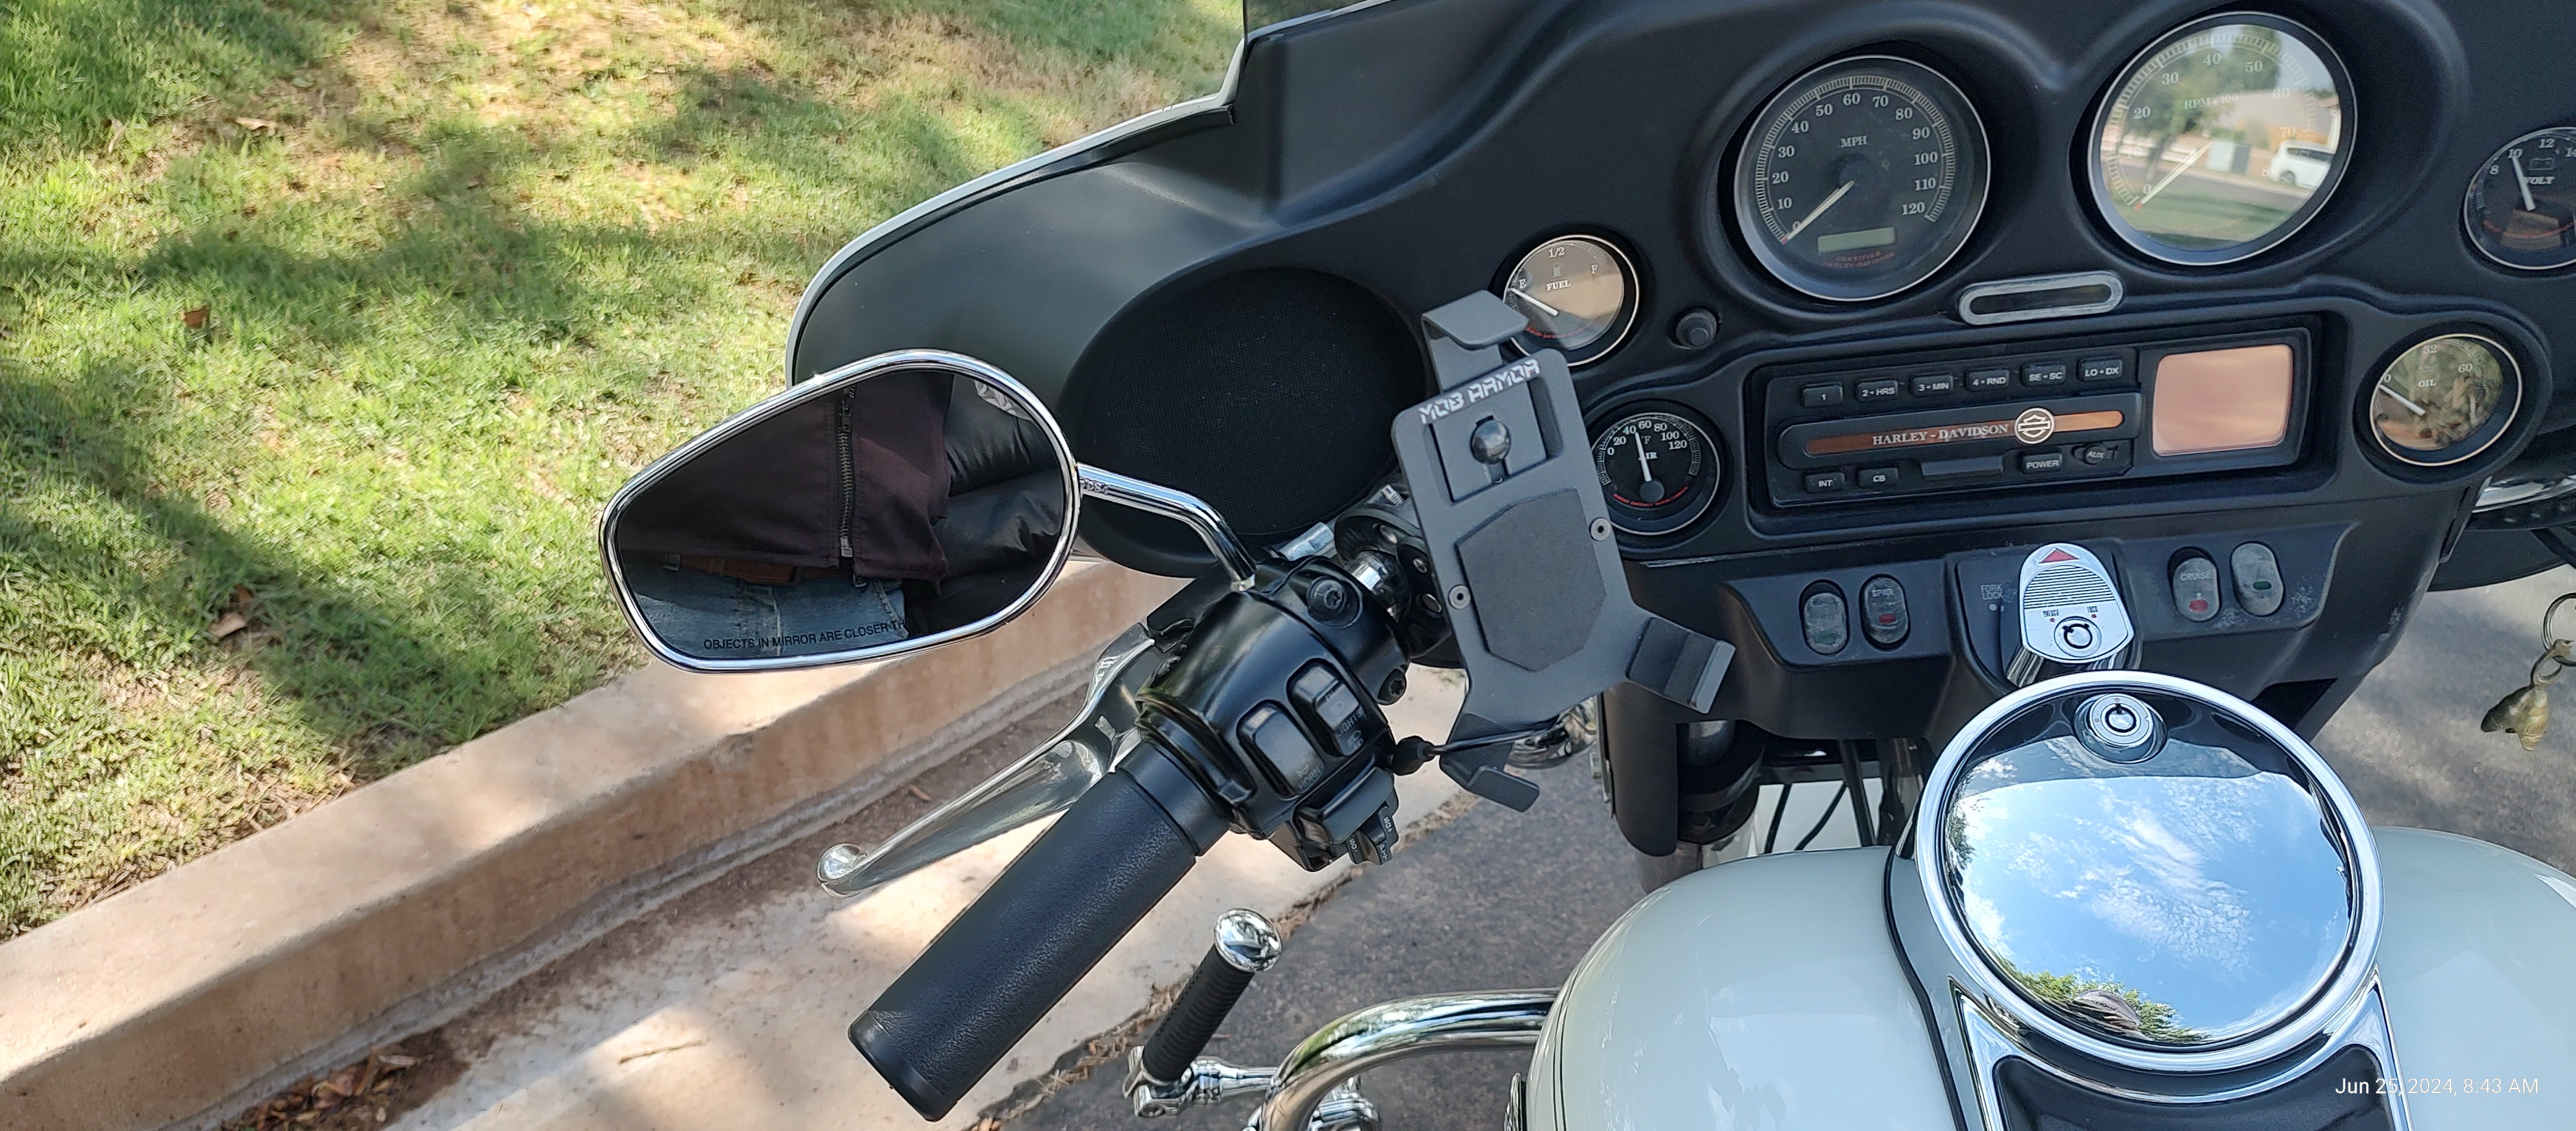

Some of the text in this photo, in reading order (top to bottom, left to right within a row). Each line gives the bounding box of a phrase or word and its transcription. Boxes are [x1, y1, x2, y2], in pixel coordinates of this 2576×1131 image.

[2203, 53, 2221, 65] 40
[2245, 60, 2263, 73] 50
[2161, 72, 2179, 85] 30
[2272, 87, 2290, 99] 60
[1842, 93, 1861, 106] 60
[1872, 95, 1889, 108] 70
[2184, 97, 2211, 109] RPM
[2221, 94, 2239, 104] 100
[1815, 104, 1833, 117] 50
[1895, 108, 1913, 120] 80
[2134, 106, 2151, 119] 20
[1791, 120, 1809, 134] 40
[1912, 127, 1930, 140] 90
[1841, 136, 1868, 148] MPH
[2538, 138, 2555, 148] 12
[1778, 145, 1795, 158] 30
[2507, 149, 2523, 158] 10
[1914, 151, 1938, 166] 100
[2262, 165, 2278, 177] 80
[2490, 166, 2499, 175] 8
[1772, 171, 1789, 184] 20
[1914, 178, 1937, 191] 110
[2143, 184, 2152, 194] 0
[1777, 197, 1792, 210] 10
[1902, 202, 1926, 216] 120
[1549, 247, 1565, 258] 1/2
[1591, 264, 1598, 274] F
[1519, 279, 1527, 289] E
[1546, 280, 1571, 291] FUEL
[2458, 363, 2472, 373] 60
[2384, 374, 2391, 383] 0
[2418, 379, 2436, 388] OIL
[1418, 359, 1540, 424] MOB ARMOR
[1623, 426, 1636, 435] 40
[1638, 421, 1652, 429] 60
[1654, 423, 1667, 432] 80
[1613, 436, 1627, 446] 20
[1661, 431, 1680, 441] 100
[1607, 447, 1615, 455] 0
[1669, 440, 1687, 450] 120
[2026, 460, 2060, 469] POWER
[2180, 571, 2211, 581] CRUISE
[1980, 584, 2002, 593] FORK
[703, 638, 755, 650] OBJECTS
[757, 637, 770, 647] IN
[772, 631, 817, 647] MIRROR
[819, 630, 842, 643] ARE
[844, 623, 889, 640] CLOSER
[1298, 766, 1321, 790] HORN
[1379, 844, 1388, 860] PTT
